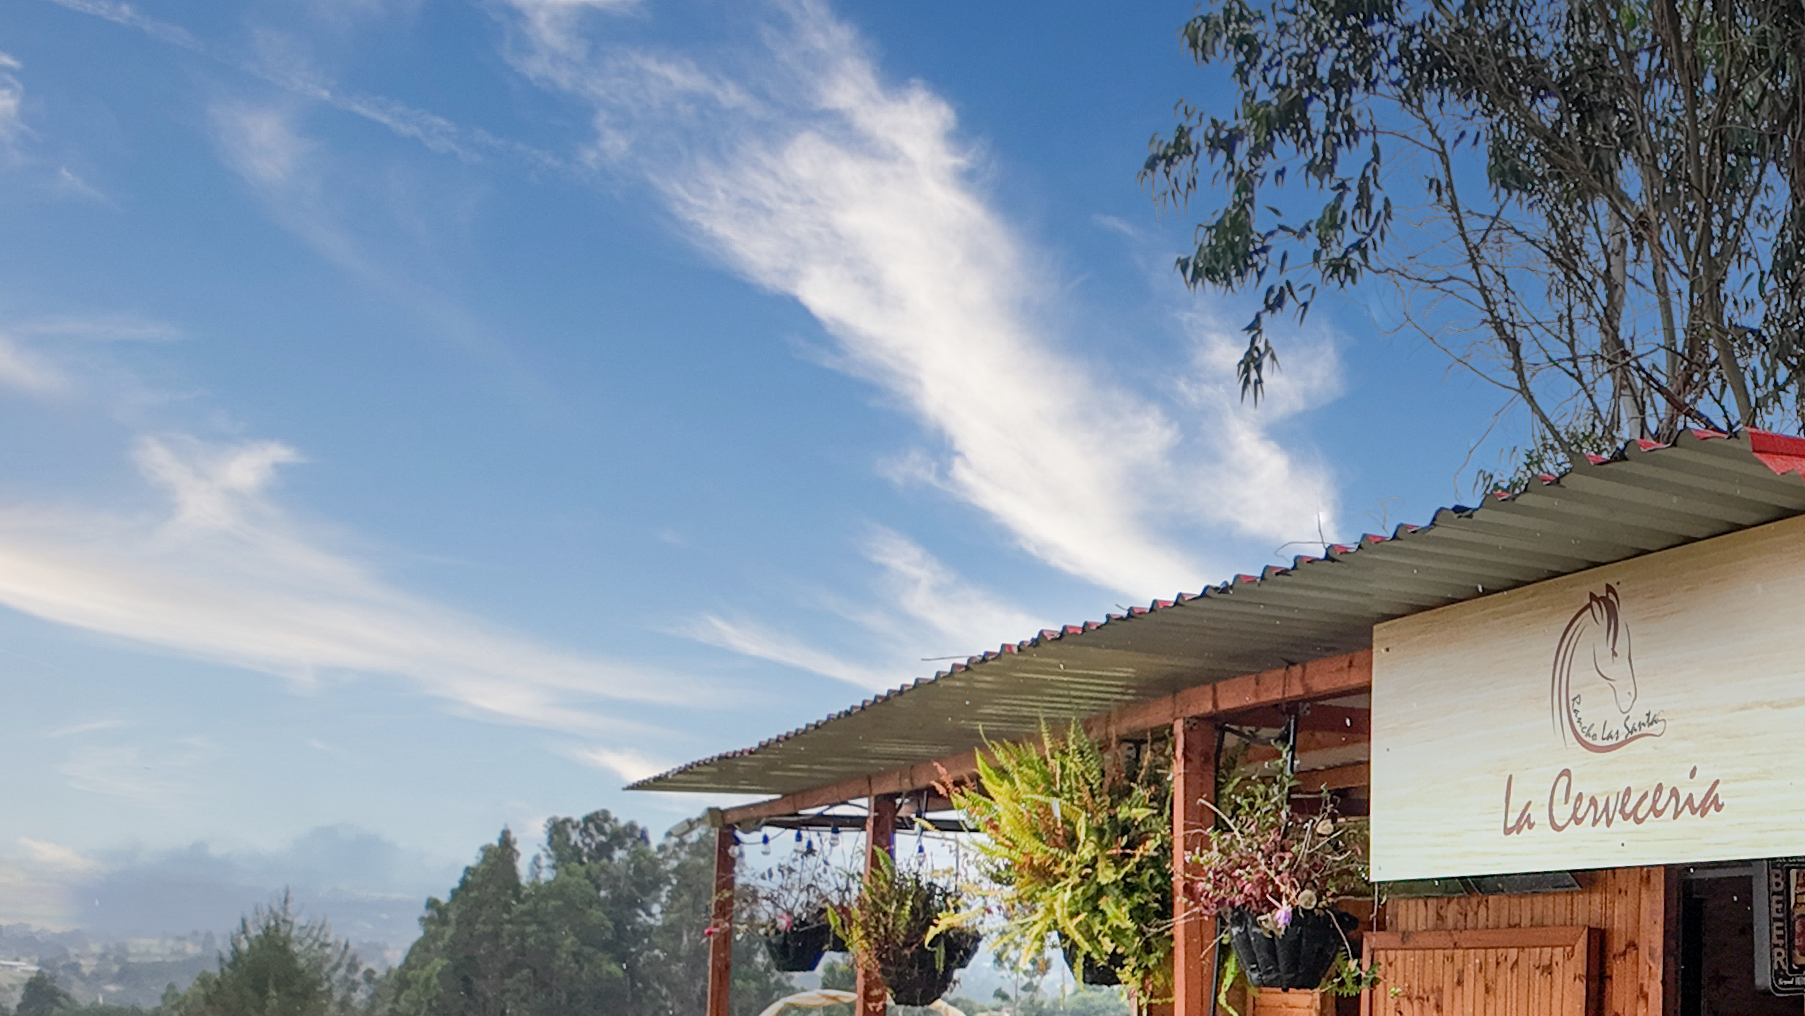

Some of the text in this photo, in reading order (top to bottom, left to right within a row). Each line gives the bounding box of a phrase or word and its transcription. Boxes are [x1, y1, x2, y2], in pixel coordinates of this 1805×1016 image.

[1601, 719, 1620, 741] Las
[1503, 774, 1535, 836] La
[1772, 869, 1787, 970] BEER
